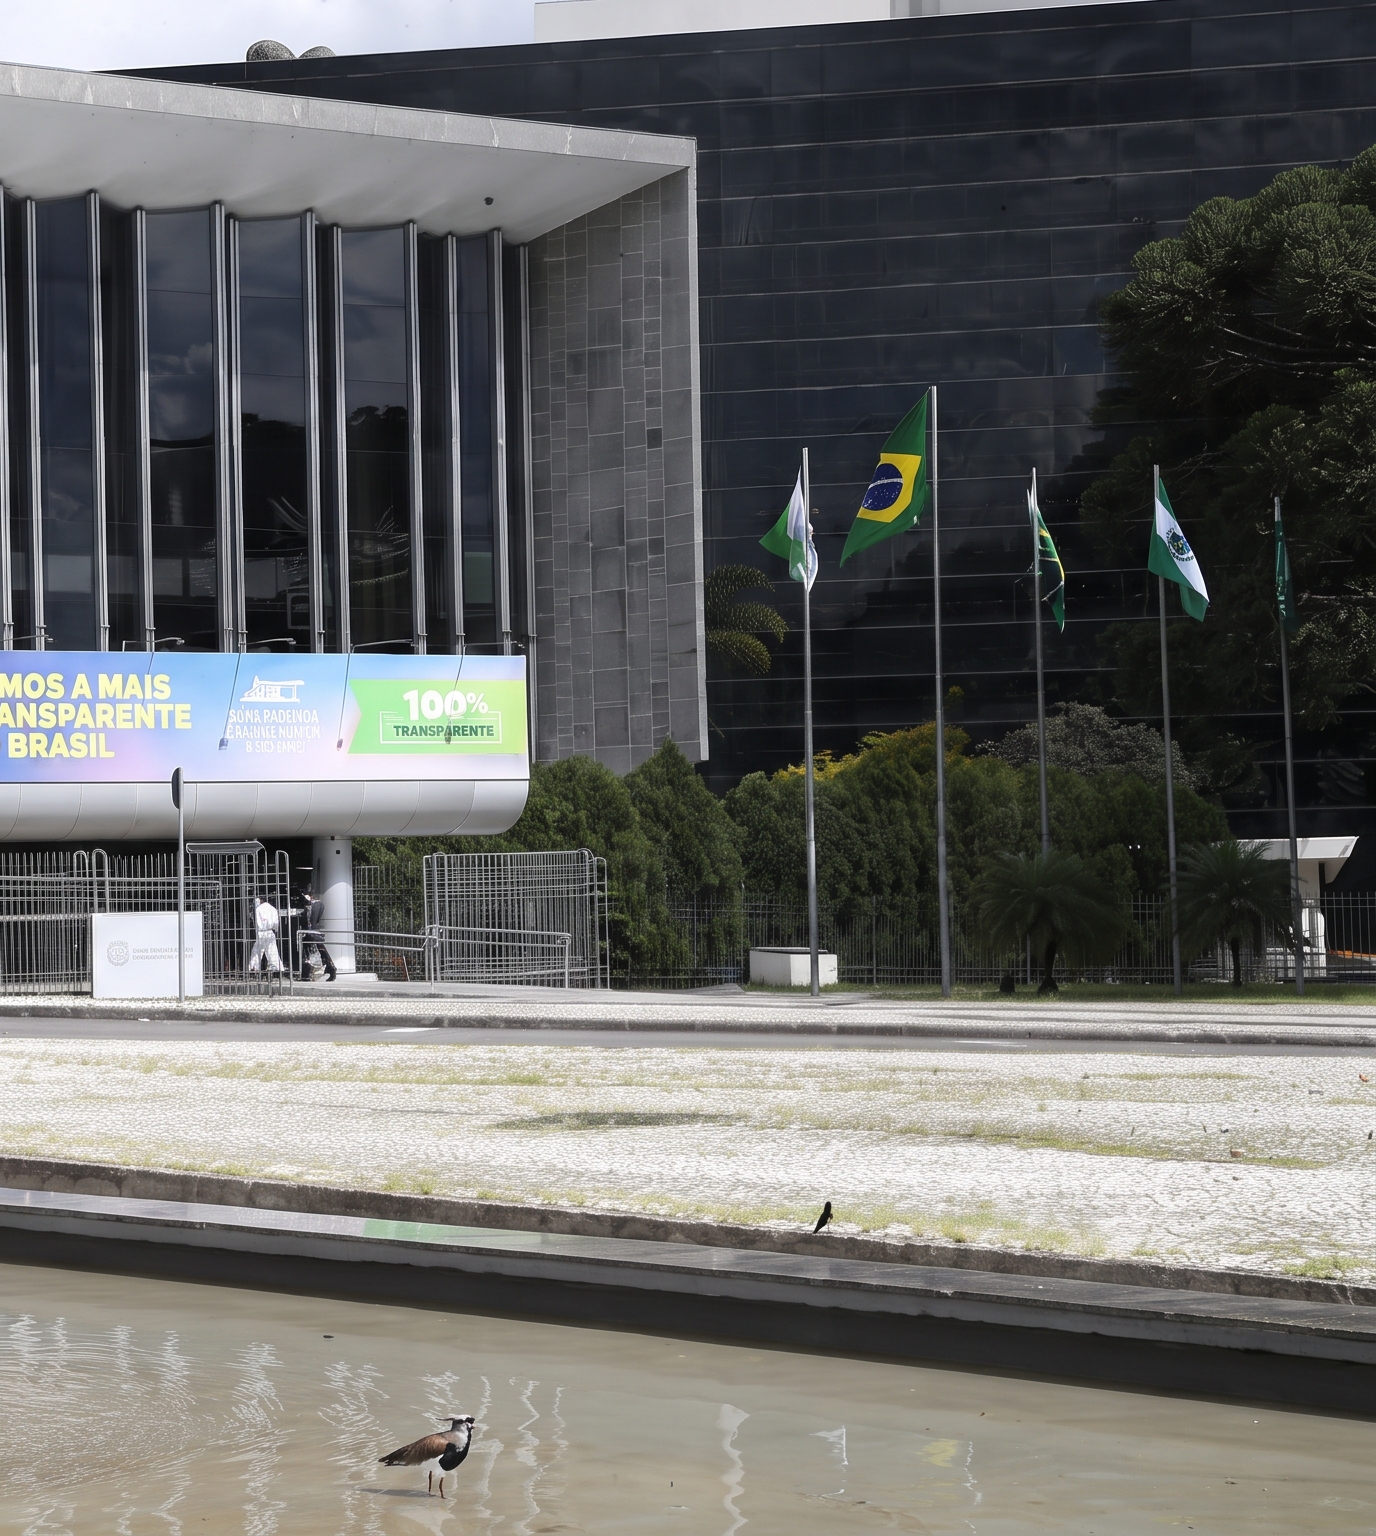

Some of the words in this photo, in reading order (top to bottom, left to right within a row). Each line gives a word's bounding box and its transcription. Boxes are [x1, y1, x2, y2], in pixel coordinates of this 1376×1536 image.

[70, 673, 93, 699] A
[98, 673, 171, 700] MAIS
[402, 689, 489, 721] 100%
[393, 725, 495, 737] TRANSPARENTE
[8, 732, 115, 758] BRASIL
